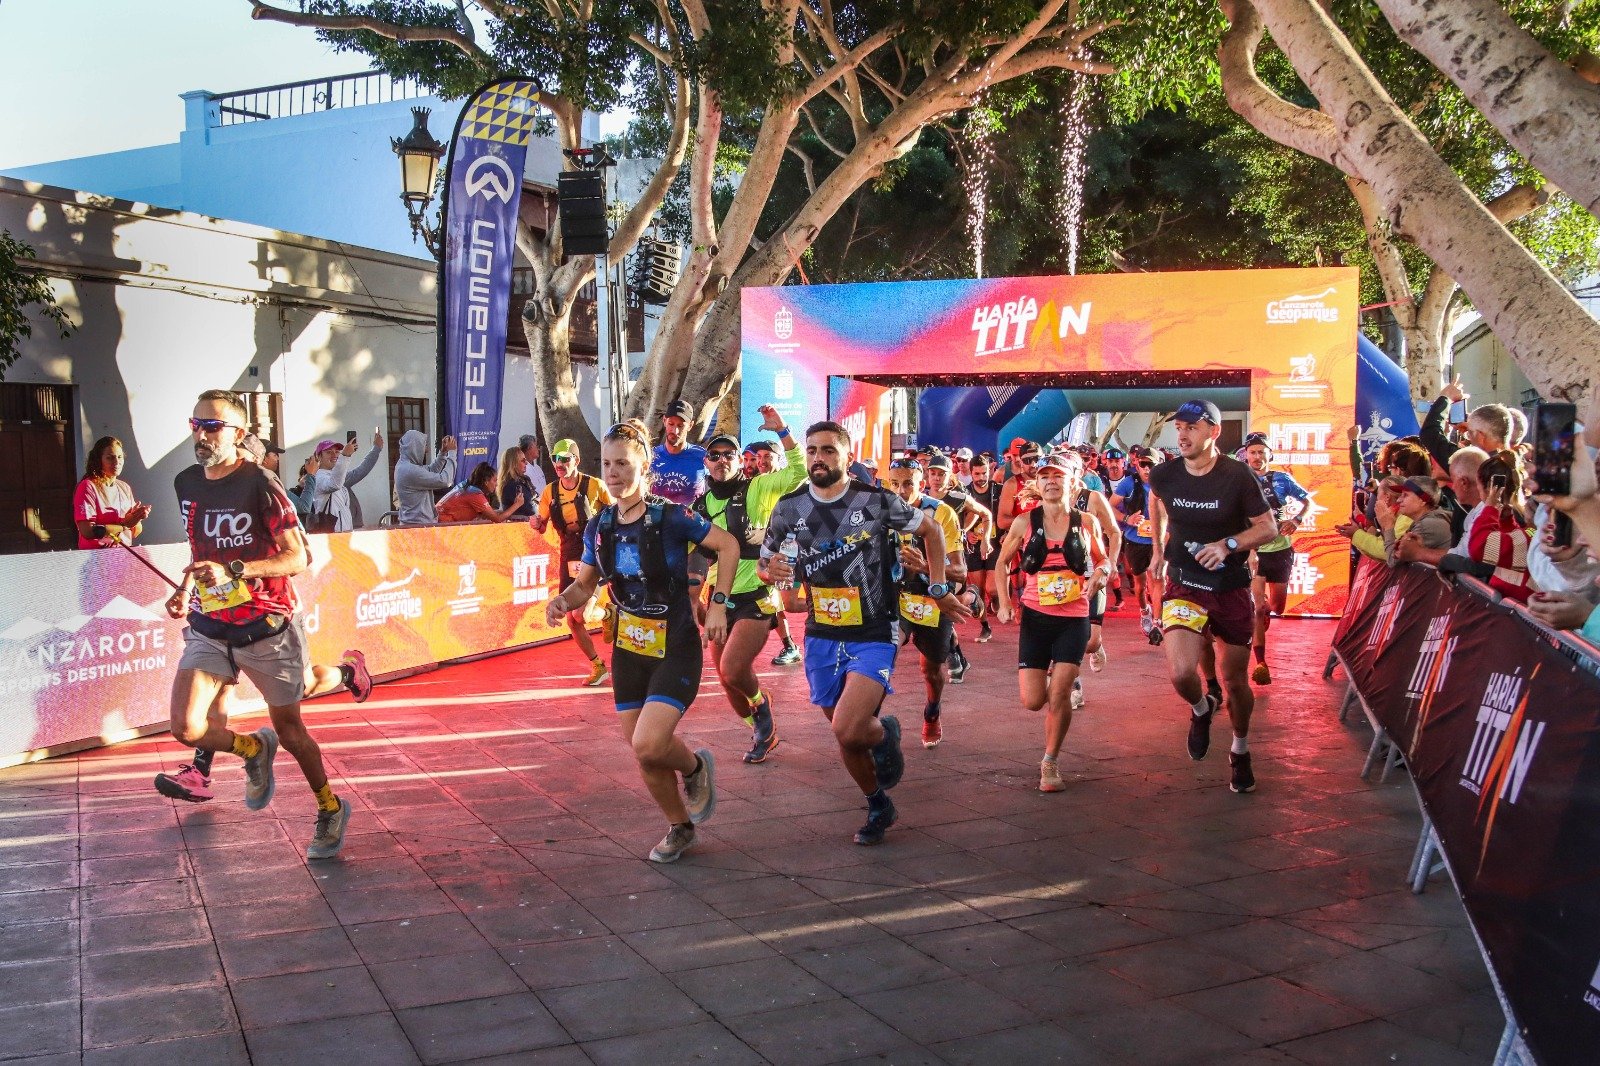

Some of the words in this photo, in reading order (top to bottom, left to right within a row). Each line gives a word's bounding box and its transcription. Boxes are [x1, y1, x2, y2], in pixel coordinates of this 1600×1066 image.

[1266, 302, 1339, 323] Geoparque
[216, 533, 253, 549] mas
[805, 542, 857, 578] RUNNERS
[1182, 580, 1213, 592] SALOMON
[356, 593, 423, 622] Geoparque
[819, 597, 851, 613] 520
[624, 625, 657, 643] 464
[67, 655, 167, 684] DESTINATION
[1481, 666, 1522, 714] HARÍA
[1462, 692, 1547, 805] TITAN
